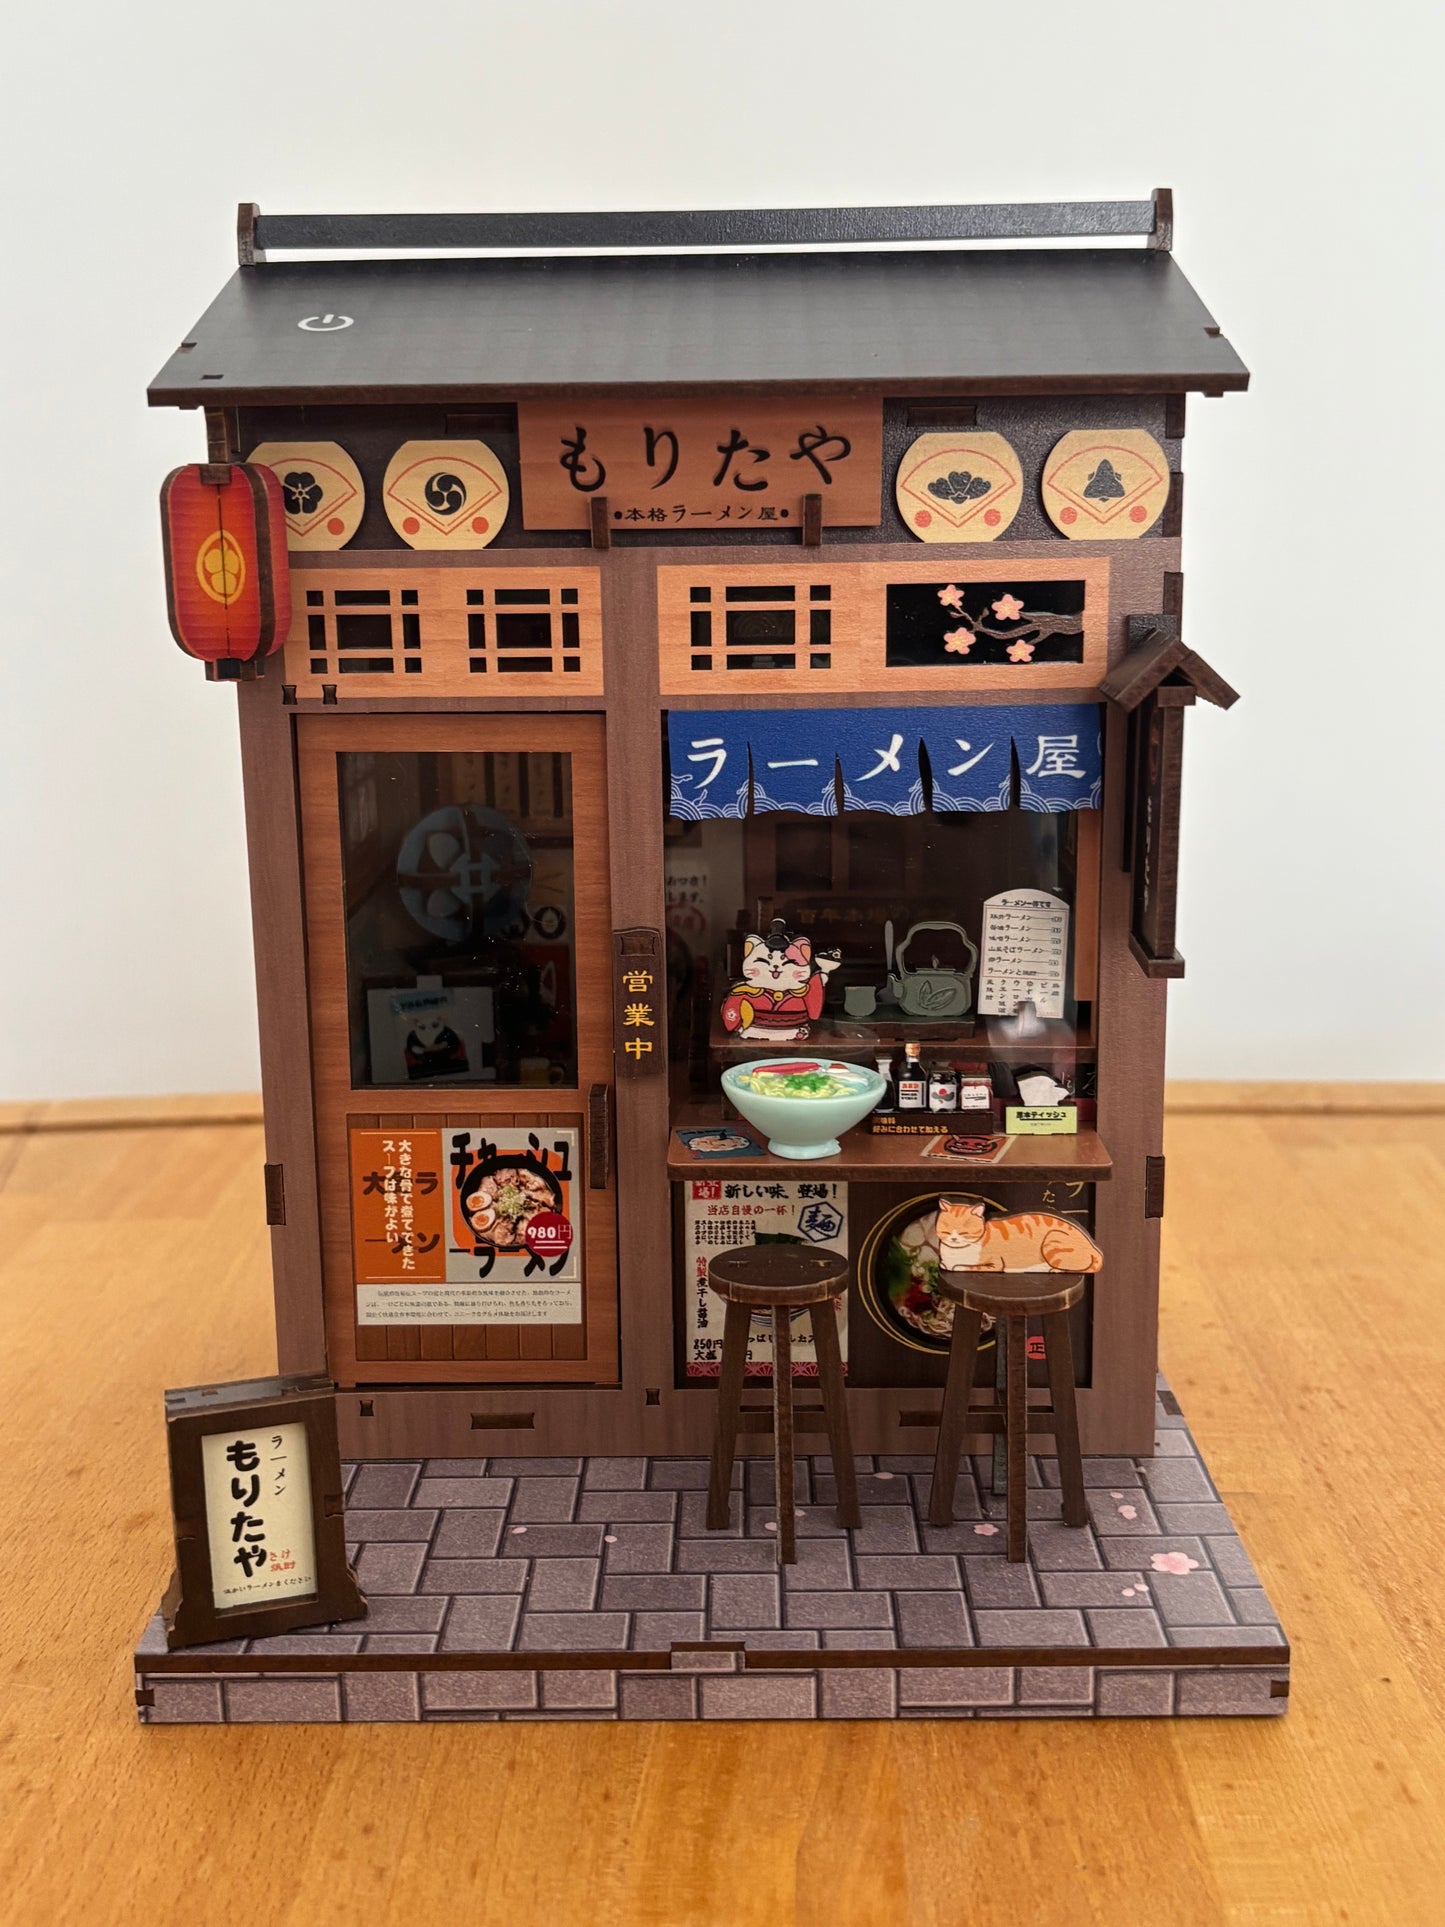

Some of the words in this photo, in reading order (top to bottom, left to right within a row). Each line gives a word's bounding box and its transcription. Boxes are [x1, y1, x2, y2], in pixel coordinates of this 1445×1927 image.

[560, 425, 851, 492] もりたや
[624, 504, 780, 523] 本格ラーメン屋
[687, 734, 1087, 789] ラーメン屋
[623, 970, 655, 1060] 営業中
[527, 1224, 572, 1240] 980円
[707, 1204, 796, 1216] 当店自慢の一杯！
[270, 1435, 288, 1496] ラーメン
[226, 1440, 267, 1578] もりたや
